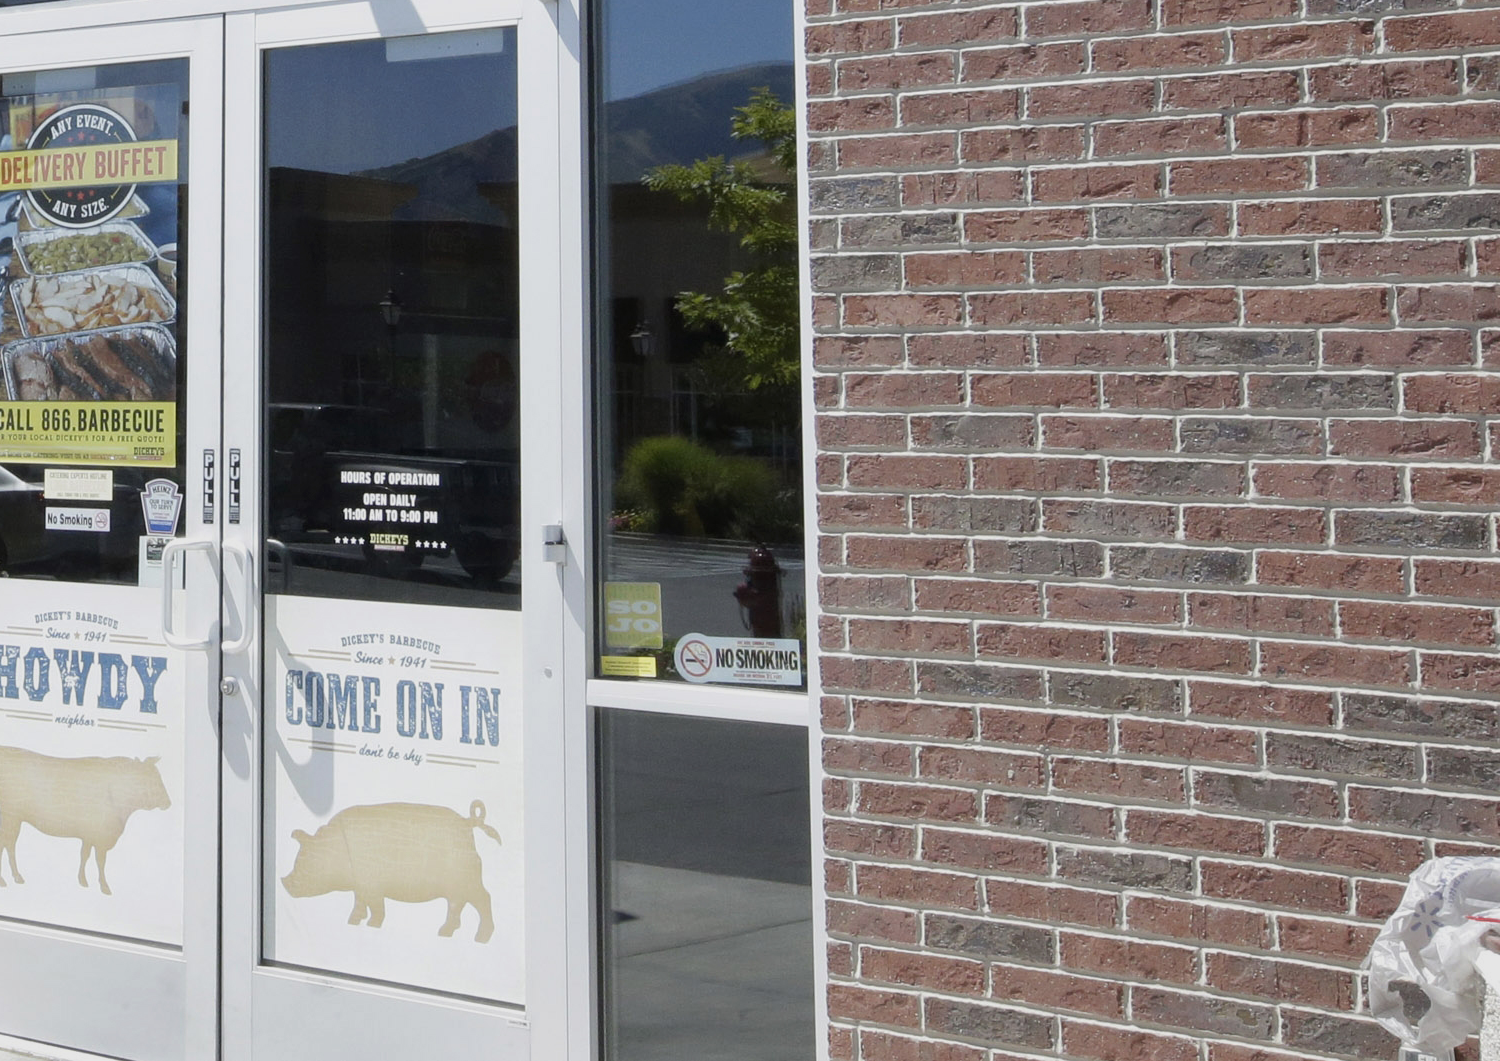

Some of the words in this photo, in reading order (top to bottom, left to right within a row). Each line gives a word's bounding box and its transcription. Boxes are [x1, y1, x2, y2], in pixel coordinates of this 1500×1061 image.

[50, 116, 73, 140] ANY
[76, 114, 114, 137] EVENT.
[1, 152, 87, 185] DELIVERY
[95, 146, 167, 179] BUFFET
[52, 200, 77, 218] ANY
[81, 197, 110, 219] SIZE.
[41, 408, 165, 433] 866.BARBECUE
[29, 434, 52, 442] LOCAL
[56, 434, 89, 442] DICKEY'S
[117, 435, 135, 443] FREE
[204, 454, 213, 507] PULL
[230, 453, 239, 507] PULL
[341, 471, 371, 484] HOURS
[374, 472, 386, 484] OF
[388, 472, 440, 486] OPERATION
[152, 485, 171, 494] HEINZ
[363, 493, 387, 506] OPEN
[390, 494, 417, 507] DAILY
[47, 513, 57, 524] No
[59, 514, 93, 528] Smoking
[343, 508, 367, 521] 11:00
[369, 509, 383, 521] AM
[385, 509, 398, 522] TO
[400, 510, 421, 523] 9:00
[424, 511, 438, 524] PM
[607, 600, 657, 614] SO
[34, 611, 72, 624] DICKEY'S
[75, 611, 119, 630] BARBECUE
[608, 618, 659, 632] JO
[45, 627, 71, 640] Since
[83, 630, 108, 643] 1941
[340, 633, 385, 647] DICKEY'S
[389, 634, 441, 655] BARBECUE
[354, 651, 384, 666] Since
[400, 655, 428, 669] 1941
[716, 648, 735, 668] NO
[736, 648, 799, 671] SMOKING
[285, 669, 381, 734] COME
[396, 679, 445, 741] ON
[459, 685, 501, 747] IN
[55, 714, 96, 728] neighbor
[359, 744, 384, 758] don't
[387, 746, 400, 760] be
[403, 748, 423, 766] shy
